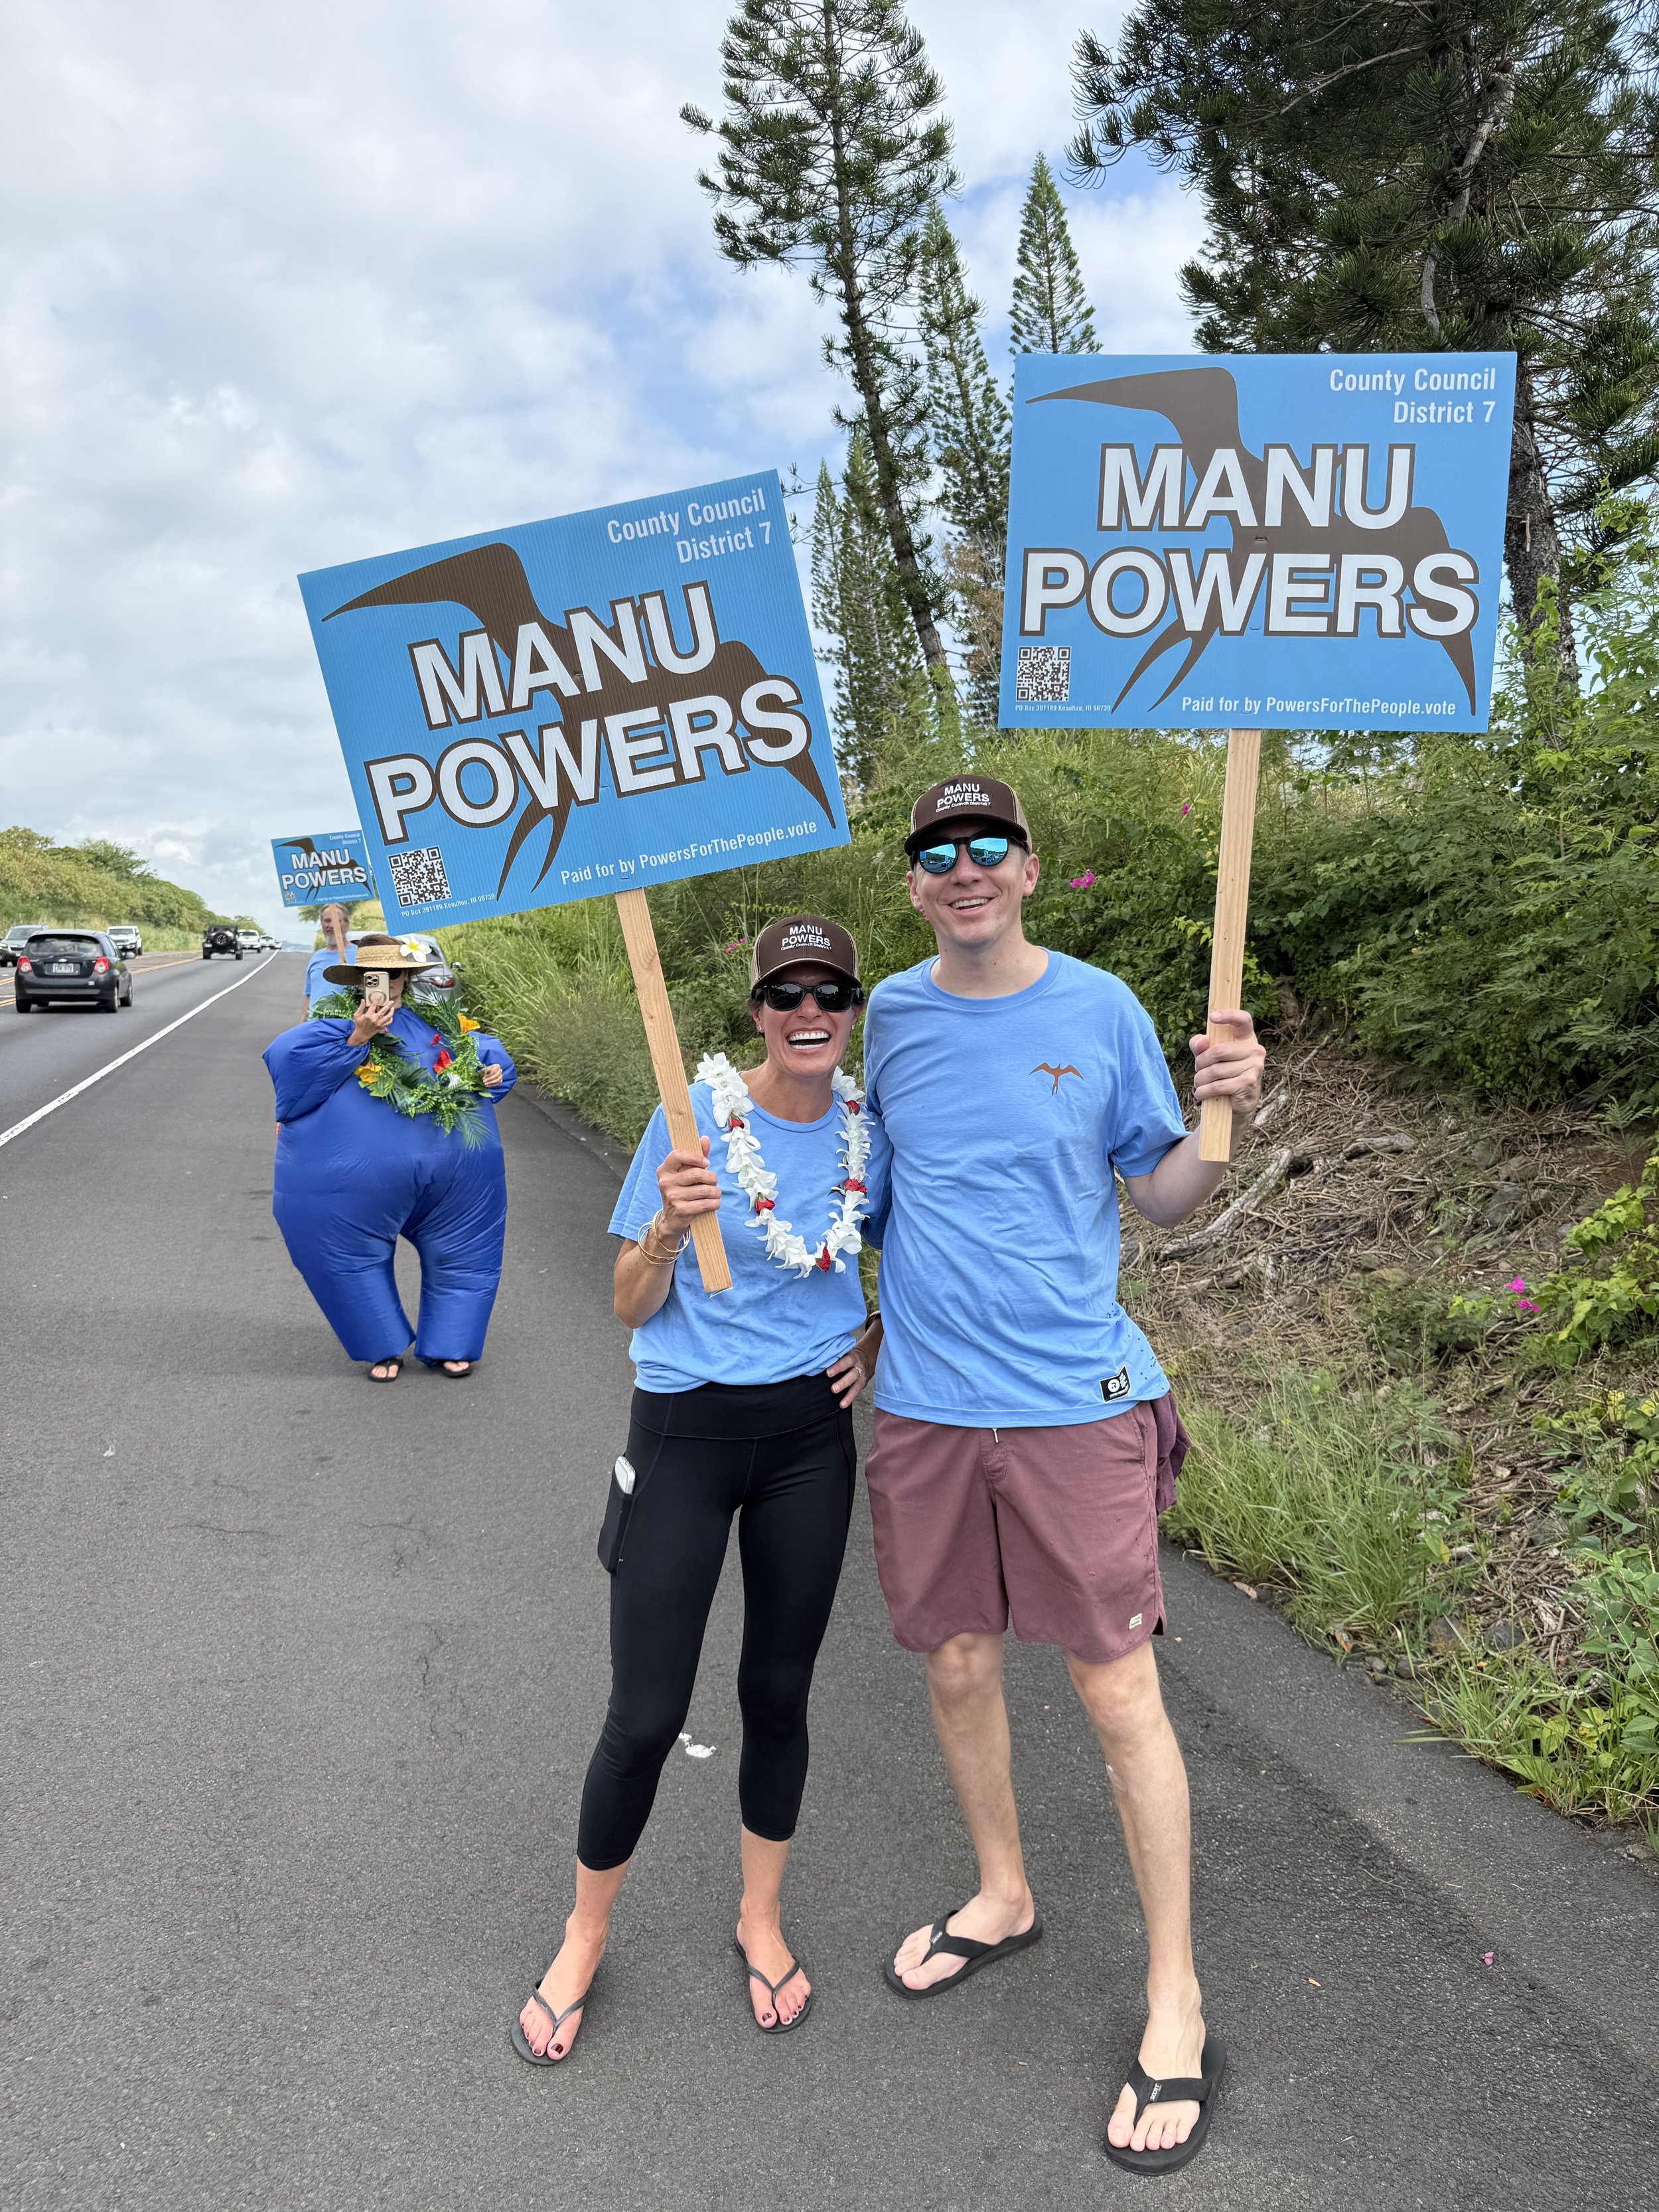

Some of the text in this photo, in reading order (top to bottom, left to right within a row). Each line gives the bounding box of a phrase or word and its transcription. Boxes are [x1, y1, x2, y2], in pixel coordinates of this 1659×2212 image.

[1329, 368, 1496, 396] County Council
[1394, 401, 1496, 423] District 7
[1098, 444, 1415, 531] MANU
[607, 488, 766, 544] County Council
[676, 521, 771, 563] District 7
[1021, 548, 1478, 639] POWERS
[408, 581, 720, 730] MANU
[1181, 697, 1456, 717] Paid for by PowersForThePeople.vote
[365, 675, 811, 845] POWERS
[936, 792, 989, 808] POWERS
[944, 783, 980, 796] MANU
[291, 848, 350, 870] MANU
[561, 820, 817, 885] Paid for by PowersForThePeople.vote
[281, 867, 368, 891] POWERS
[782, 934, 831, 946] POWERS
[789, 924, 823, 936] MANU
[1149, 2083, 1160, 2101] SCOTT
